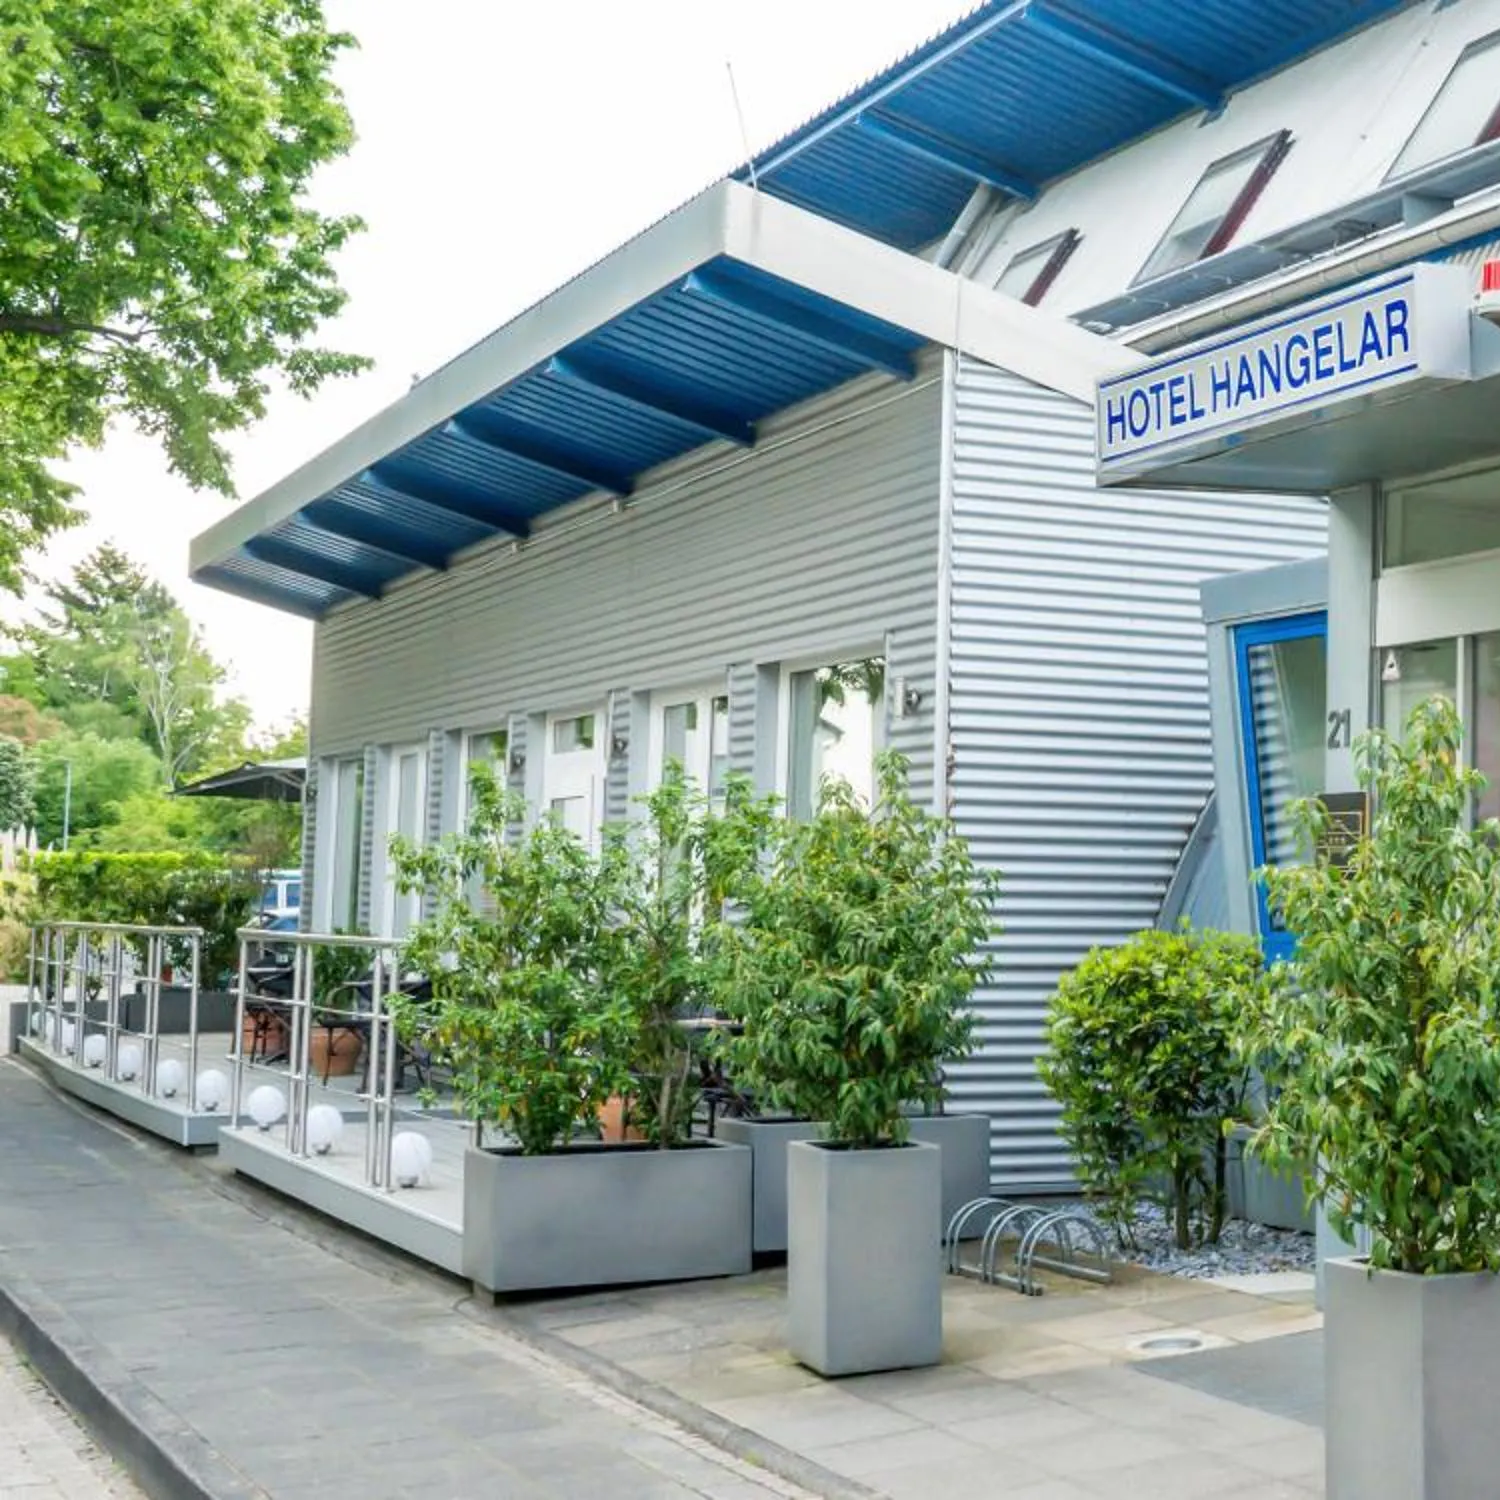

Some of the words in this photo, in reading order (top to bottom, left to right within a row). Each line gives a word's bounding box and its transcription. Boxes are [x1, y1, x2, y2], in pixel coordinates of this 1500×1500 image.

[1106, 373, 1205, 445] HOTEL
[1210, 299, 1410, 413] HANGELAR
[1327, 709, 1351, 749] 21
